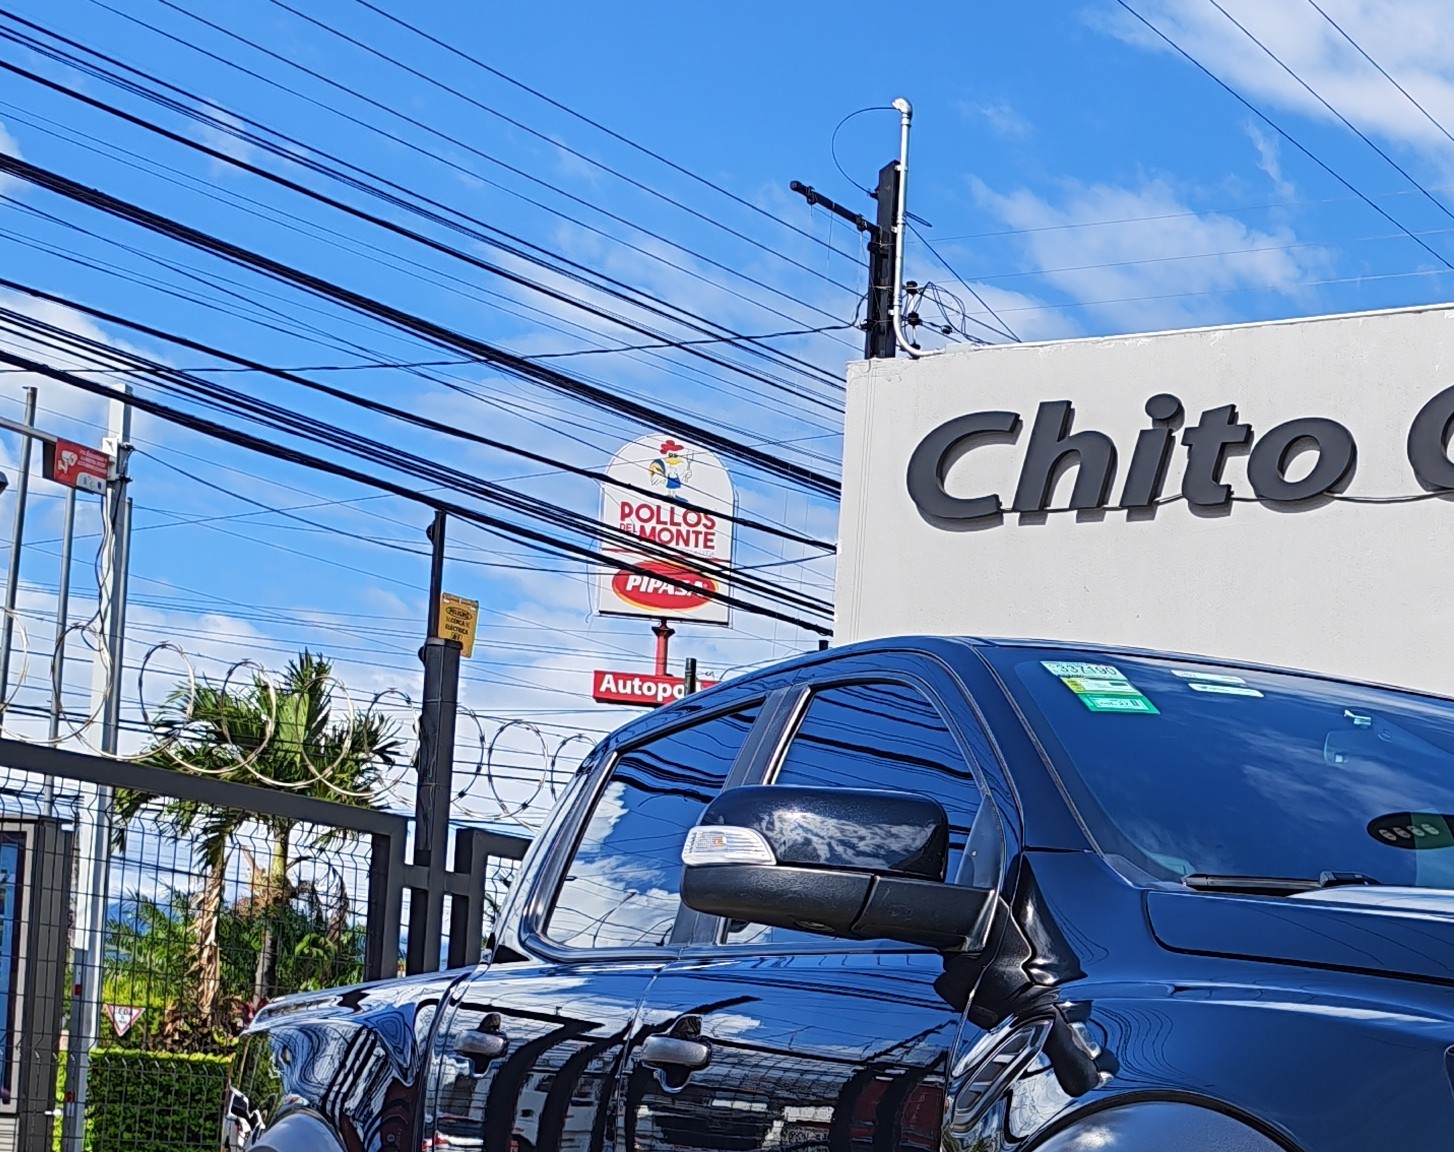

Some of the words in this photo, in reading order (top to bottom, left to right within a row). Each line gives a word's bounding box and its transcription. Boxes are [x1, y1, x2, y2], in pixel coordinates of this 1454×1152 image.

[906, 393, 1358, 522] Chito
[619, 501, 716, 530] POLLOS
[639, 525, 716, 550] MONTE
[600, 674, 702, 702] Autopo
